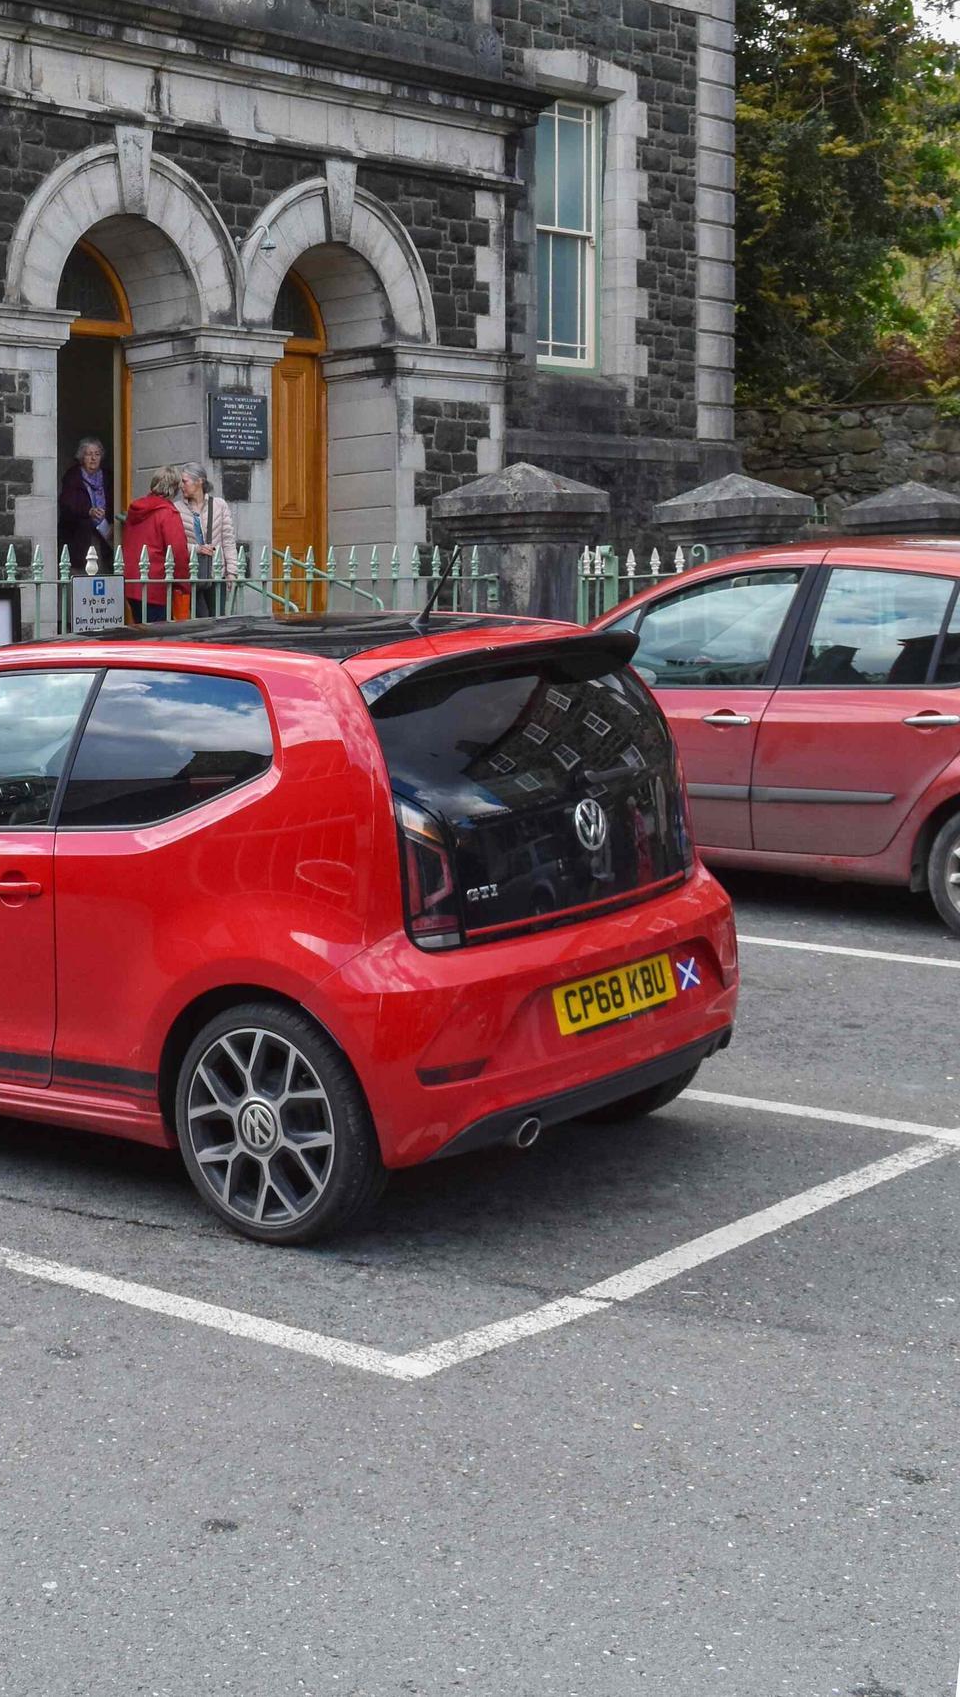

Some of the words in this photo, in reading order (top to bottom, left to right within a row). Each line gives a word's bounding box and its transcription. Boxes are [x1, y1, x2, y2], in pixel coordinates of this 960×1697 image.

[96, 582, 104, 594] P
[90, 616, 123, 625] dychwelyd
[466, 883, 499, 902] GTI
[564, 974, 625, 1024] CP68
[629, 961, 667, 1002] KBU
